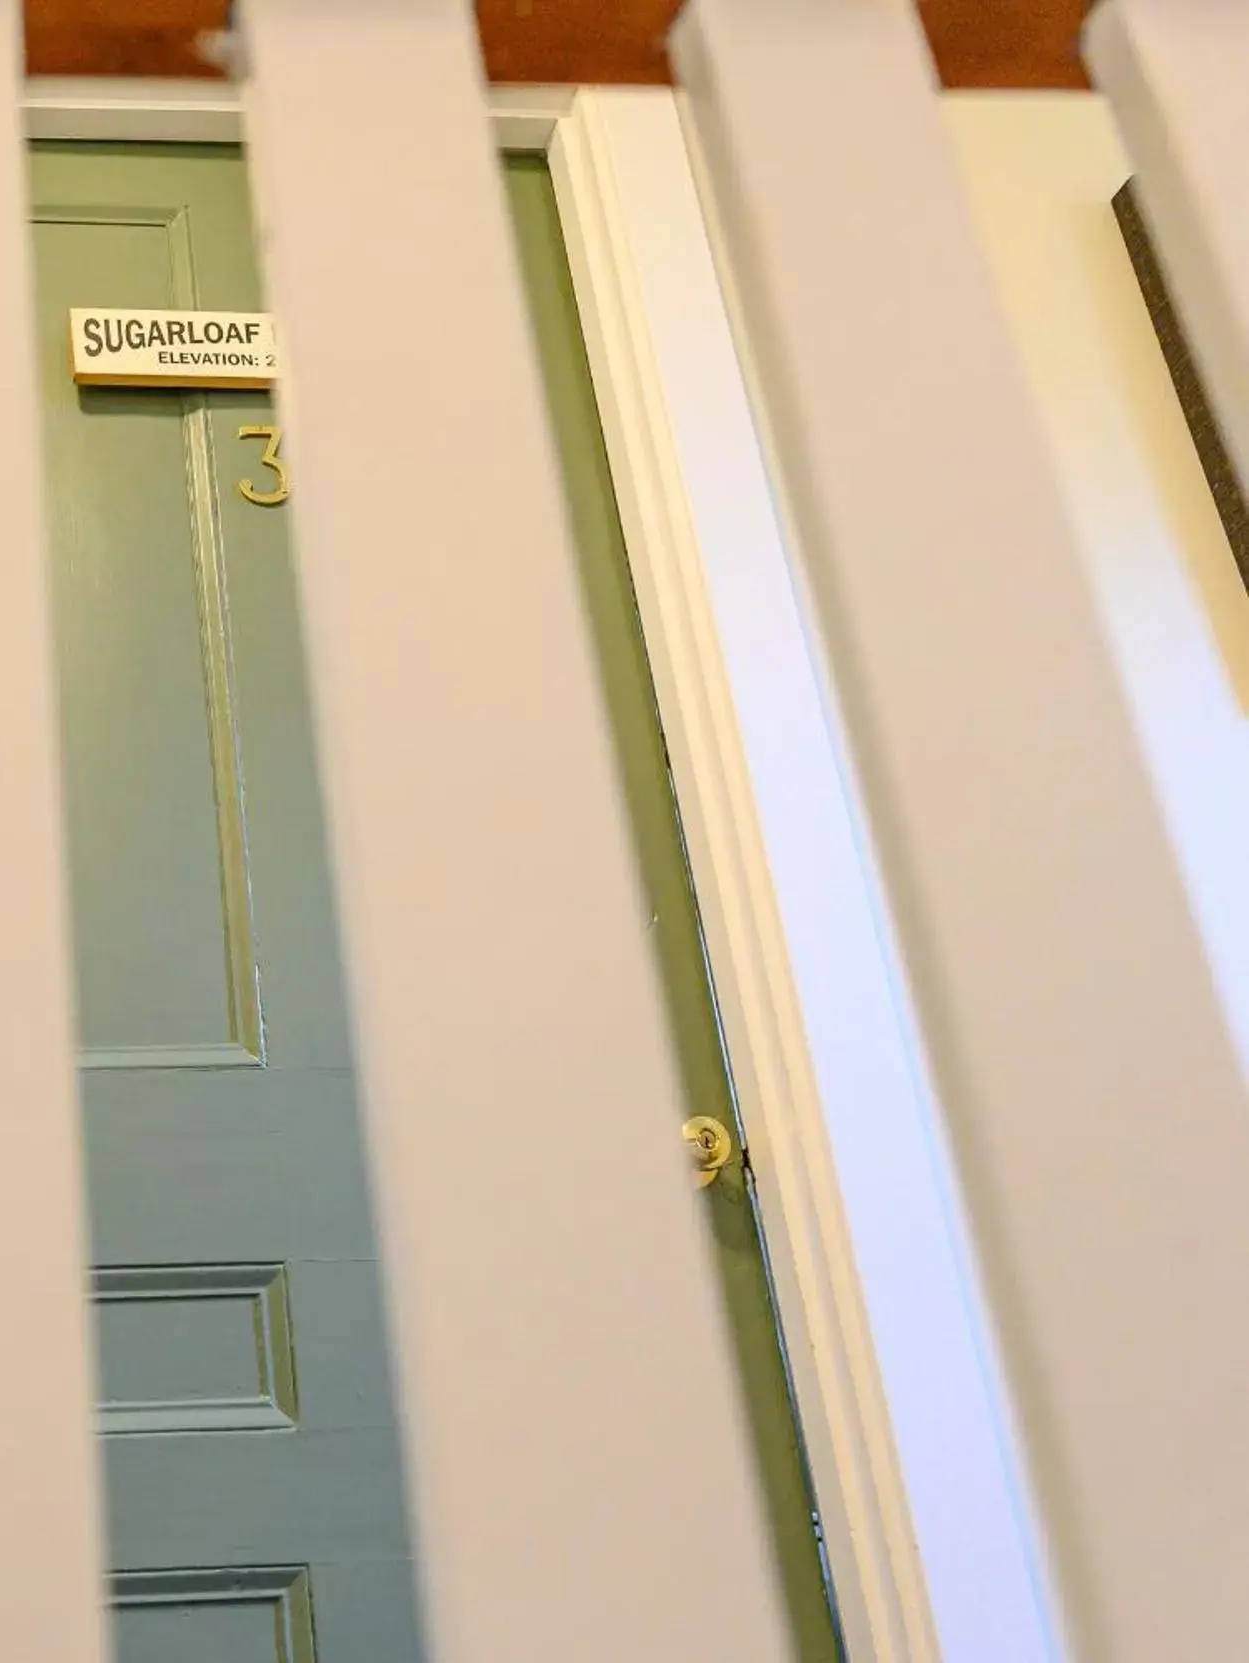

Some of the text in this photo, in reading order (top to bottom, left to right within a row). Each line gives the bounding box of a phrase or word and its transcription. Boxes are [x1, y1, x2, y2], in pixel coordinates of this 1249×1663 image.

[83, 317, 260, 357] SUGARLOAF
[158, 350, 260, 366] ELEVATION:
[239, 426, 288, 508] 3
